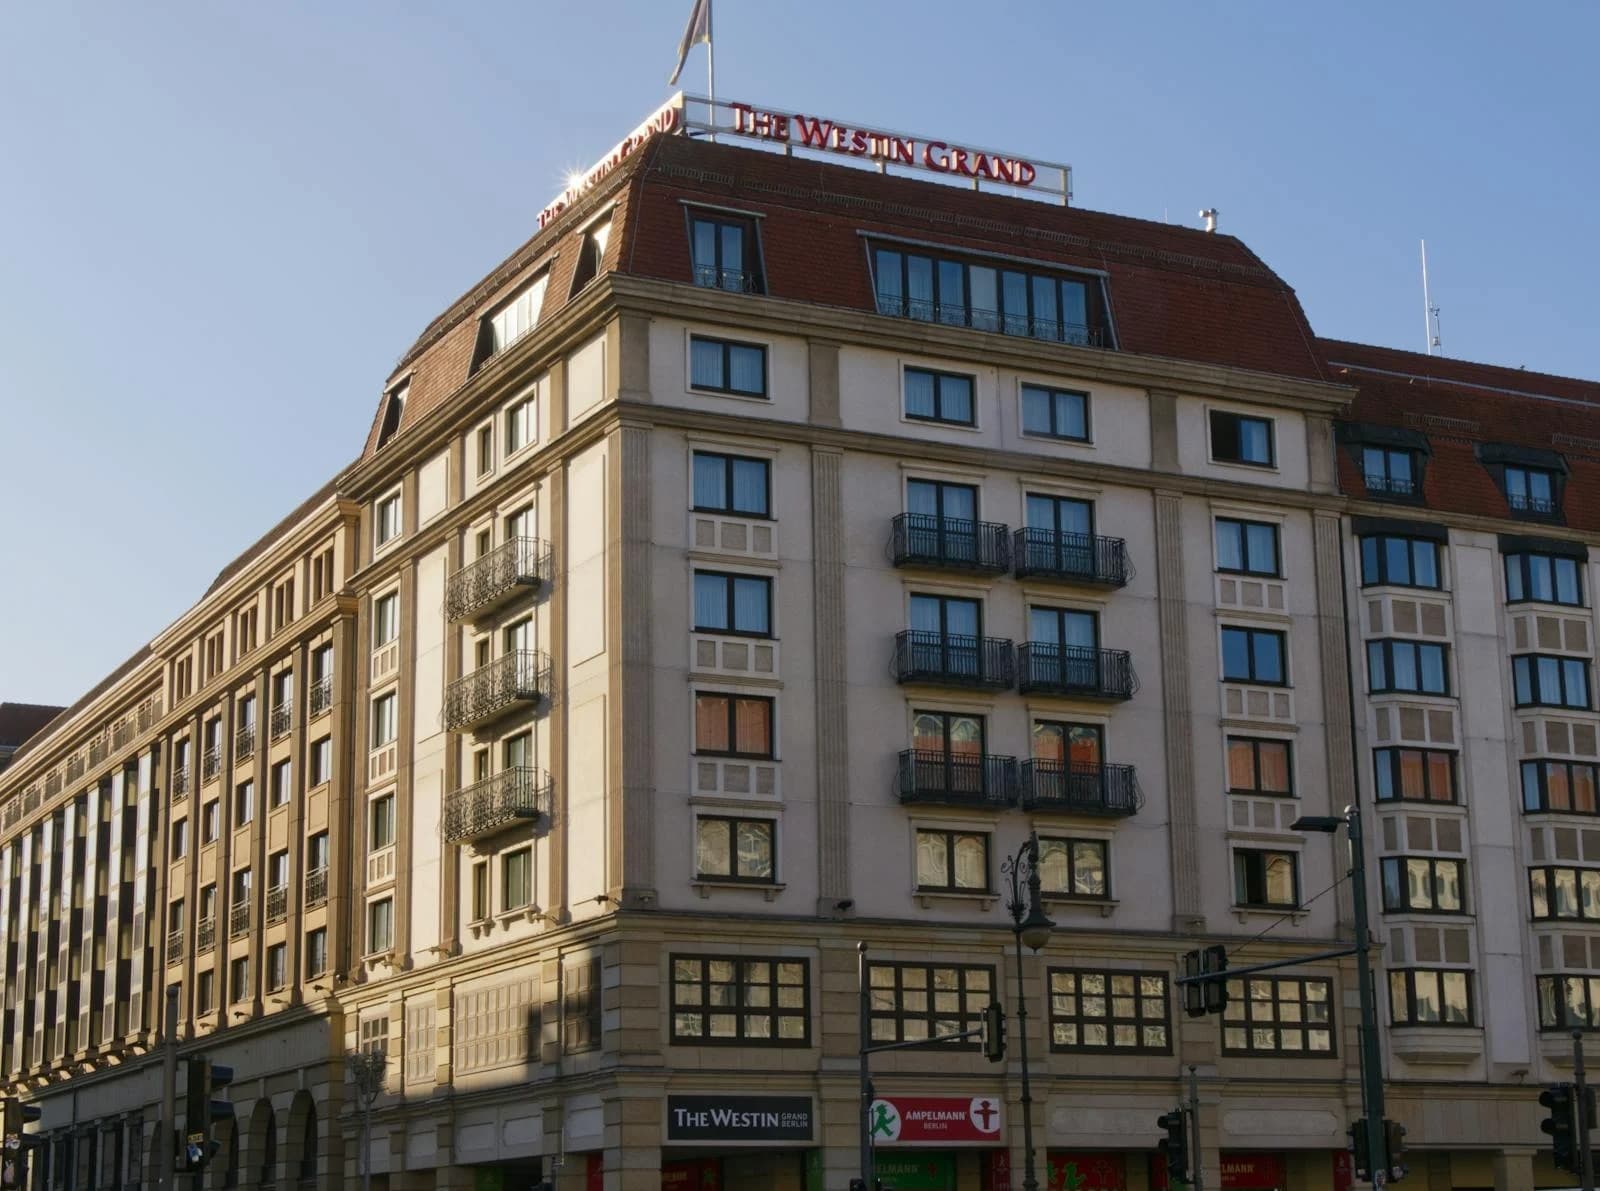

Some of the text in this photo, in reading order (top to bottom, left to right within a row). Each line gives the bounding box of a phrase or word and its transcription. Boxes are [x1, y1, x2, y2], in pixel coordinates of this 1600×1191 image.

[729, 102, 1035, 186] THE WESTIN GRAND
[566, 154, 619, 207] WSTIN
[674, 1108, 779, 1128] THE WESTIN
[781, 1112, 808, 1121] GRAND
[905, 1110, 966, 1121] AMPELMANN
[781, 1120, 808, 1128] BERLIN
[923, 1122, 948, 1130] BERLIN
